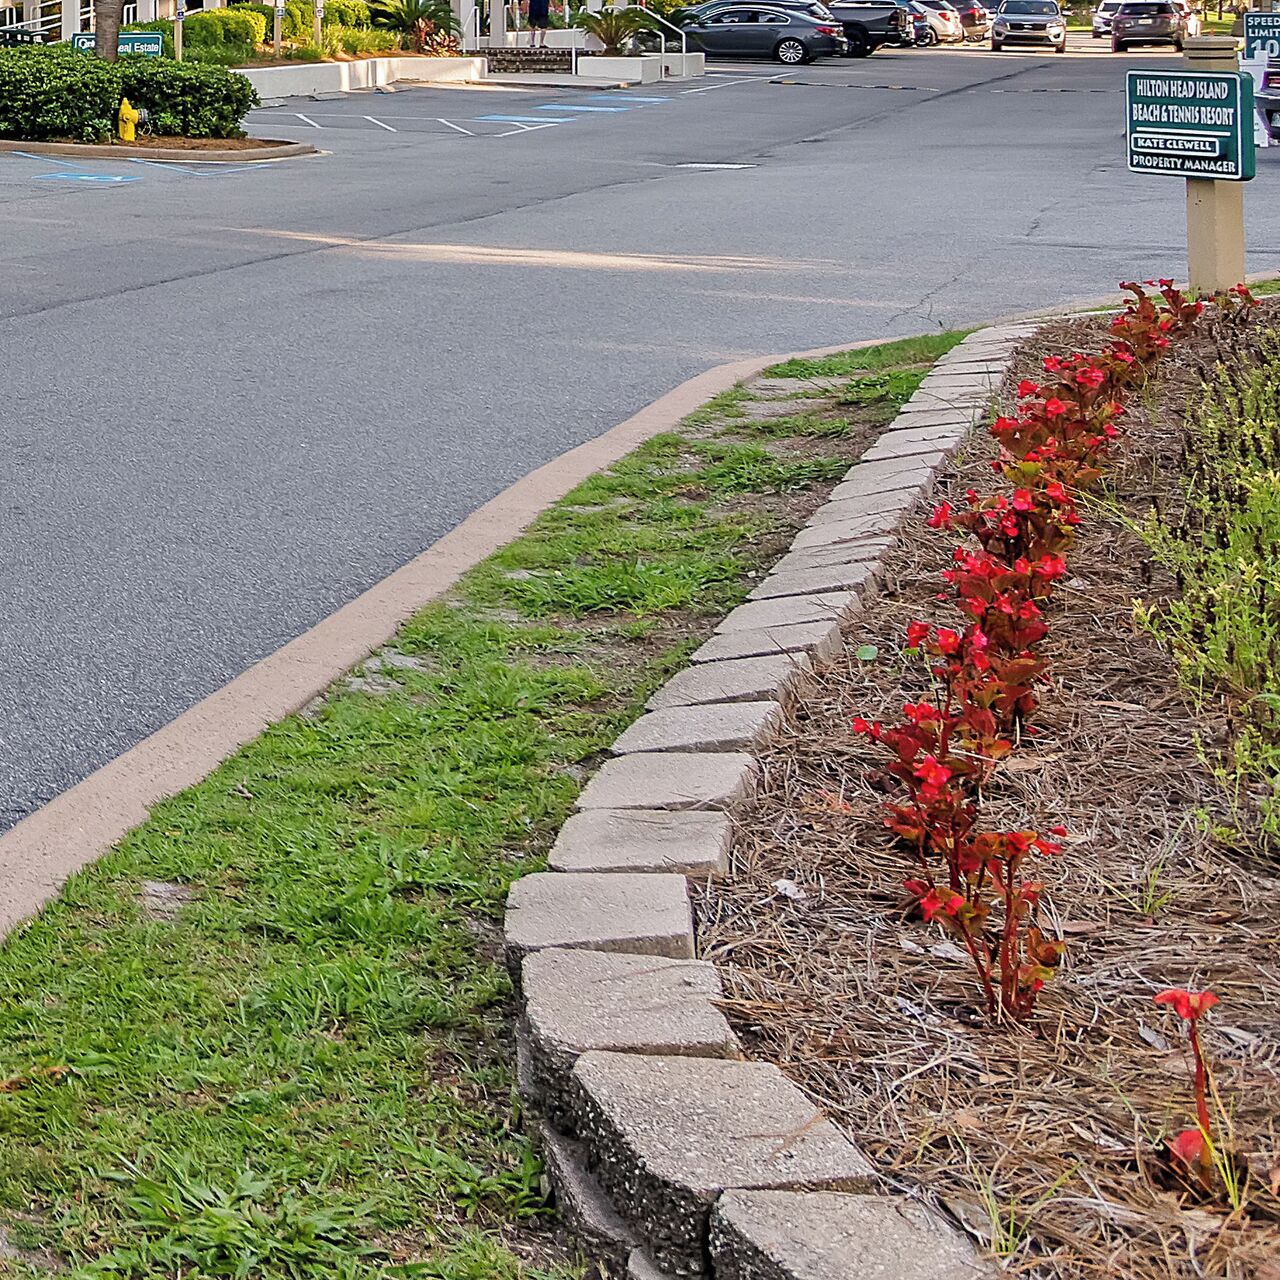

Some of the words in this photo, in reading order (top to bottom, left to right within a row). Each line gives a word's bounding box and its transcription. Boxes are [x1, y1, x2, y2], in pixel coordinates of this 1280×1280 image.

[1248, 17, 1280, 26] SPEED
[1249, 28, 1280, 37] LIMIT
[118, 42, 131, 52] eal
[134, 42, 159, 52] Estate
[1251, 40, 1279, 58] 10
[1136, 79, 1169, 97] HILTON
[1170, 80, 1195, 98] HEAD
[1196, 81, 1228, 99] ISLAND
[1132, 103, 1160, 122] BEACH
[1161, 105, 1168, 122] &
[1168, 105, 1200, 124] TENNIS
[1201, 106, 1234, 125] RESORT
[1137, 138, 1165, 148] KATE
[1166, 139, 1212, 151] CLEWELL
[1132, 155, 1182, 169] PROPERTY
[1184, 159, 1235, 172] MANAGER
